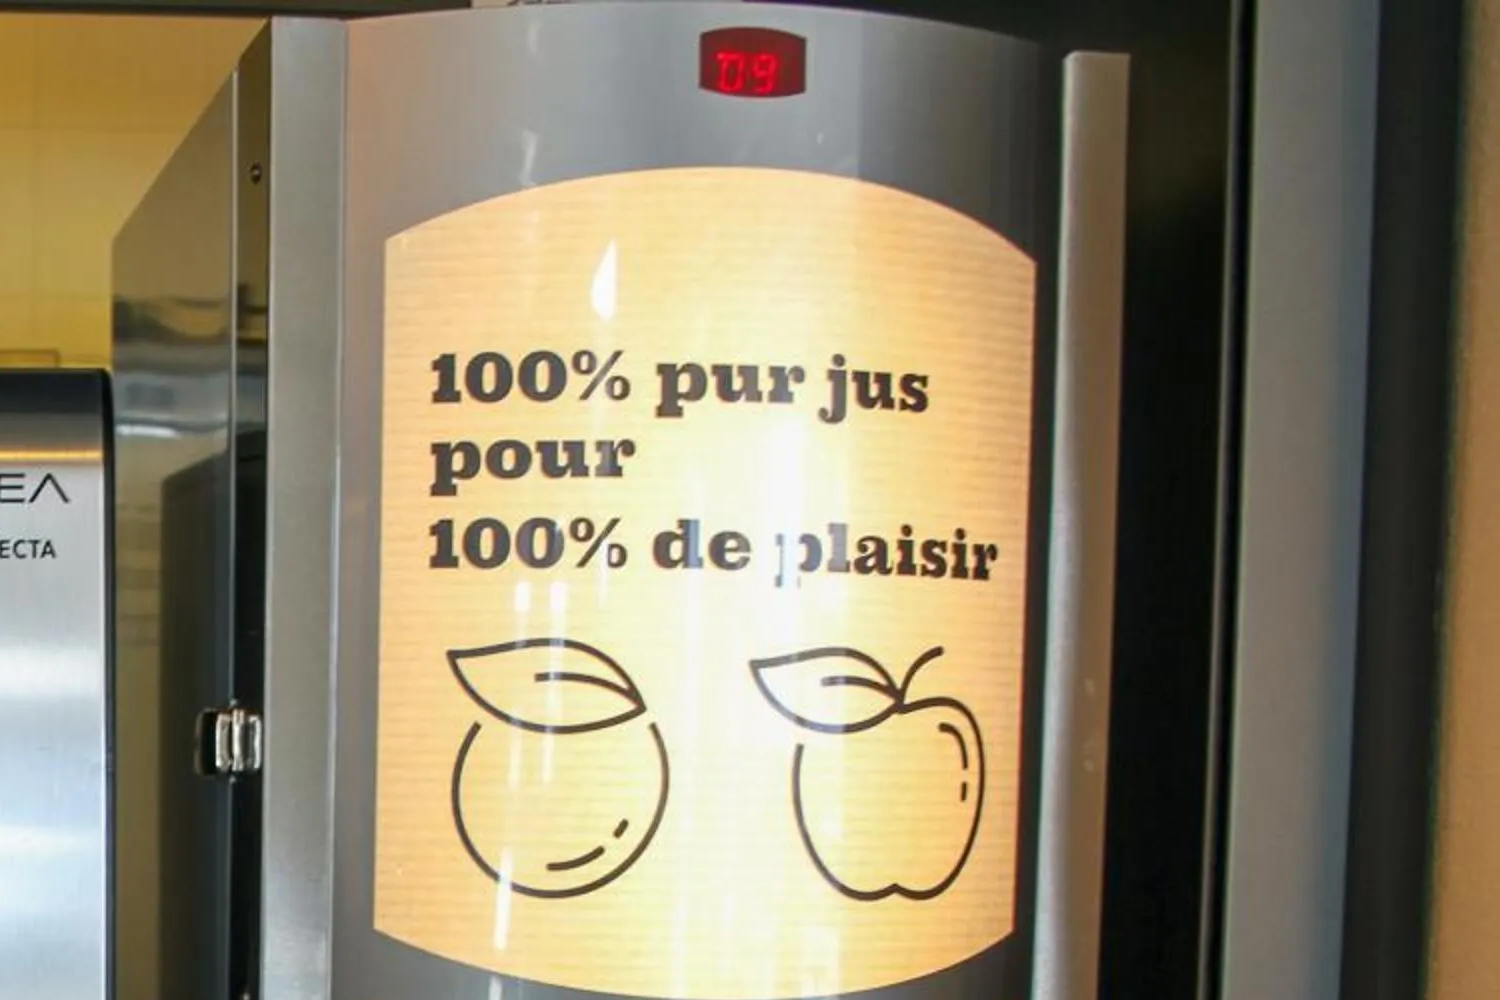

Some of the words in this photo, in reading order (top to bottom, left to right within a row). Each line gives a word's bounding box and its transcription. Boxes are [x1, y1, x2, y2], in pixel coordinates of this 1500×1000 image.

[430, 350, 631, 403] 100%
[655, 362, 805, 418] pur
[819, 354, 930, 423] jus
[430, 438, 635, 496] pour
[428, 517, 627, 569] 100%
[652, 519, 751, 571] de
[775, 521, 998, 588] plaisir
